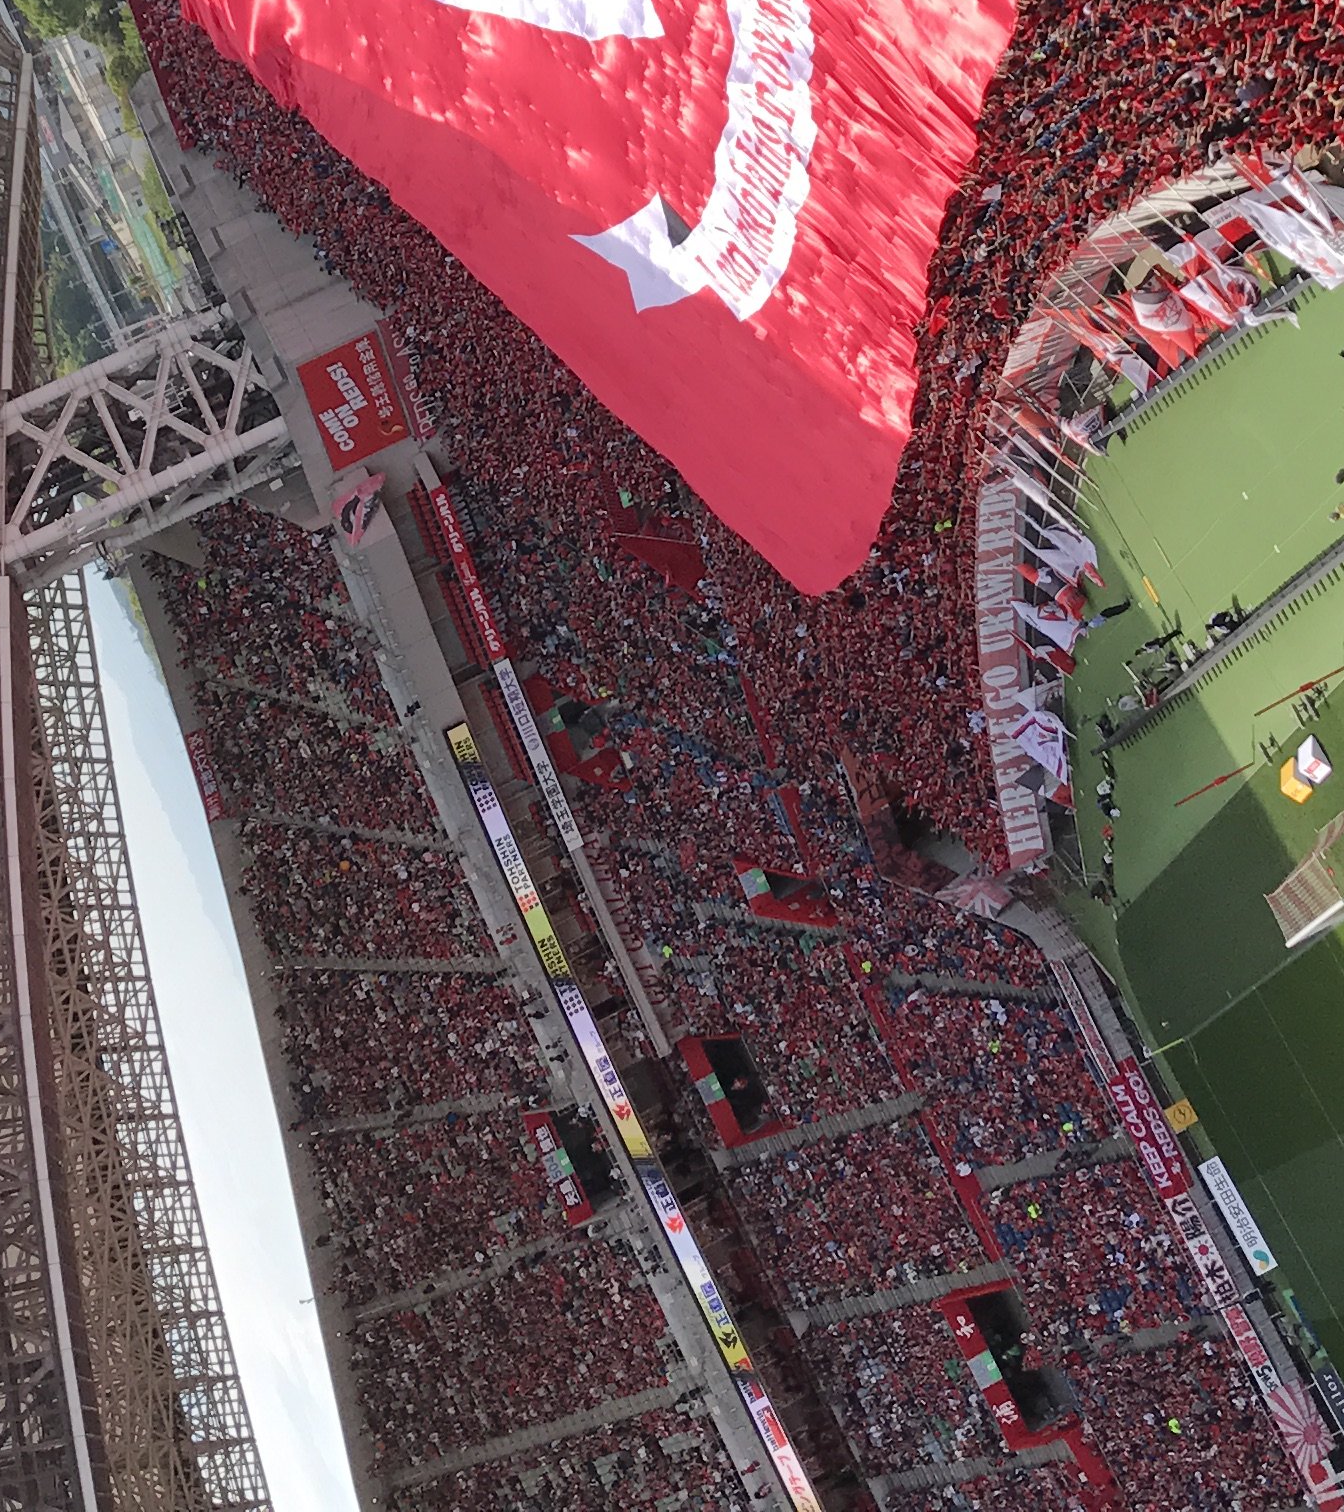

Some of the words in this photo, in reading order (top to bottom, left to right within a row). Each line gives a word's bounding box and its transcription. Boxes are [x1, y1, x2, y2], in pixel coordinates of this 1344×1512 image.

[326, 361, 368, 410] REDS!
[402, 373, 418, 391] GO
[318, 408, 355, 451] COME
[335, 403, 359, 428] ON
[975, 478, 1017, 553] REDS
[975, 555, 1019, 655] URAWA
[498, 667, 537, 739] 川口短期大学
[982, 664, 1020, 710] GO
[986, 713, 1026, 765] WE
[994, 767, 1045, 855] HERE
[493, 836, 522, 894] TOHSHIN
[503, 832, 532, 890] PARTNERS
[1111, 1084, 1148, 1137] CALM
[1124, 1069, 1150, 1104] GO!
[1142, 1106, 1177, 1158] REDS
[1142, 1144, 1173, 1189] KEEP
[1168, 1161, 1184, 1175] &
[1168, 1195, 1205, 1241] 陽介
[1204, 1160, 1261, 1248] 明治安田生命
[1204, 1259, 1236, 1305] 柏木
[1256, 1364, 1273, 1376] 5
